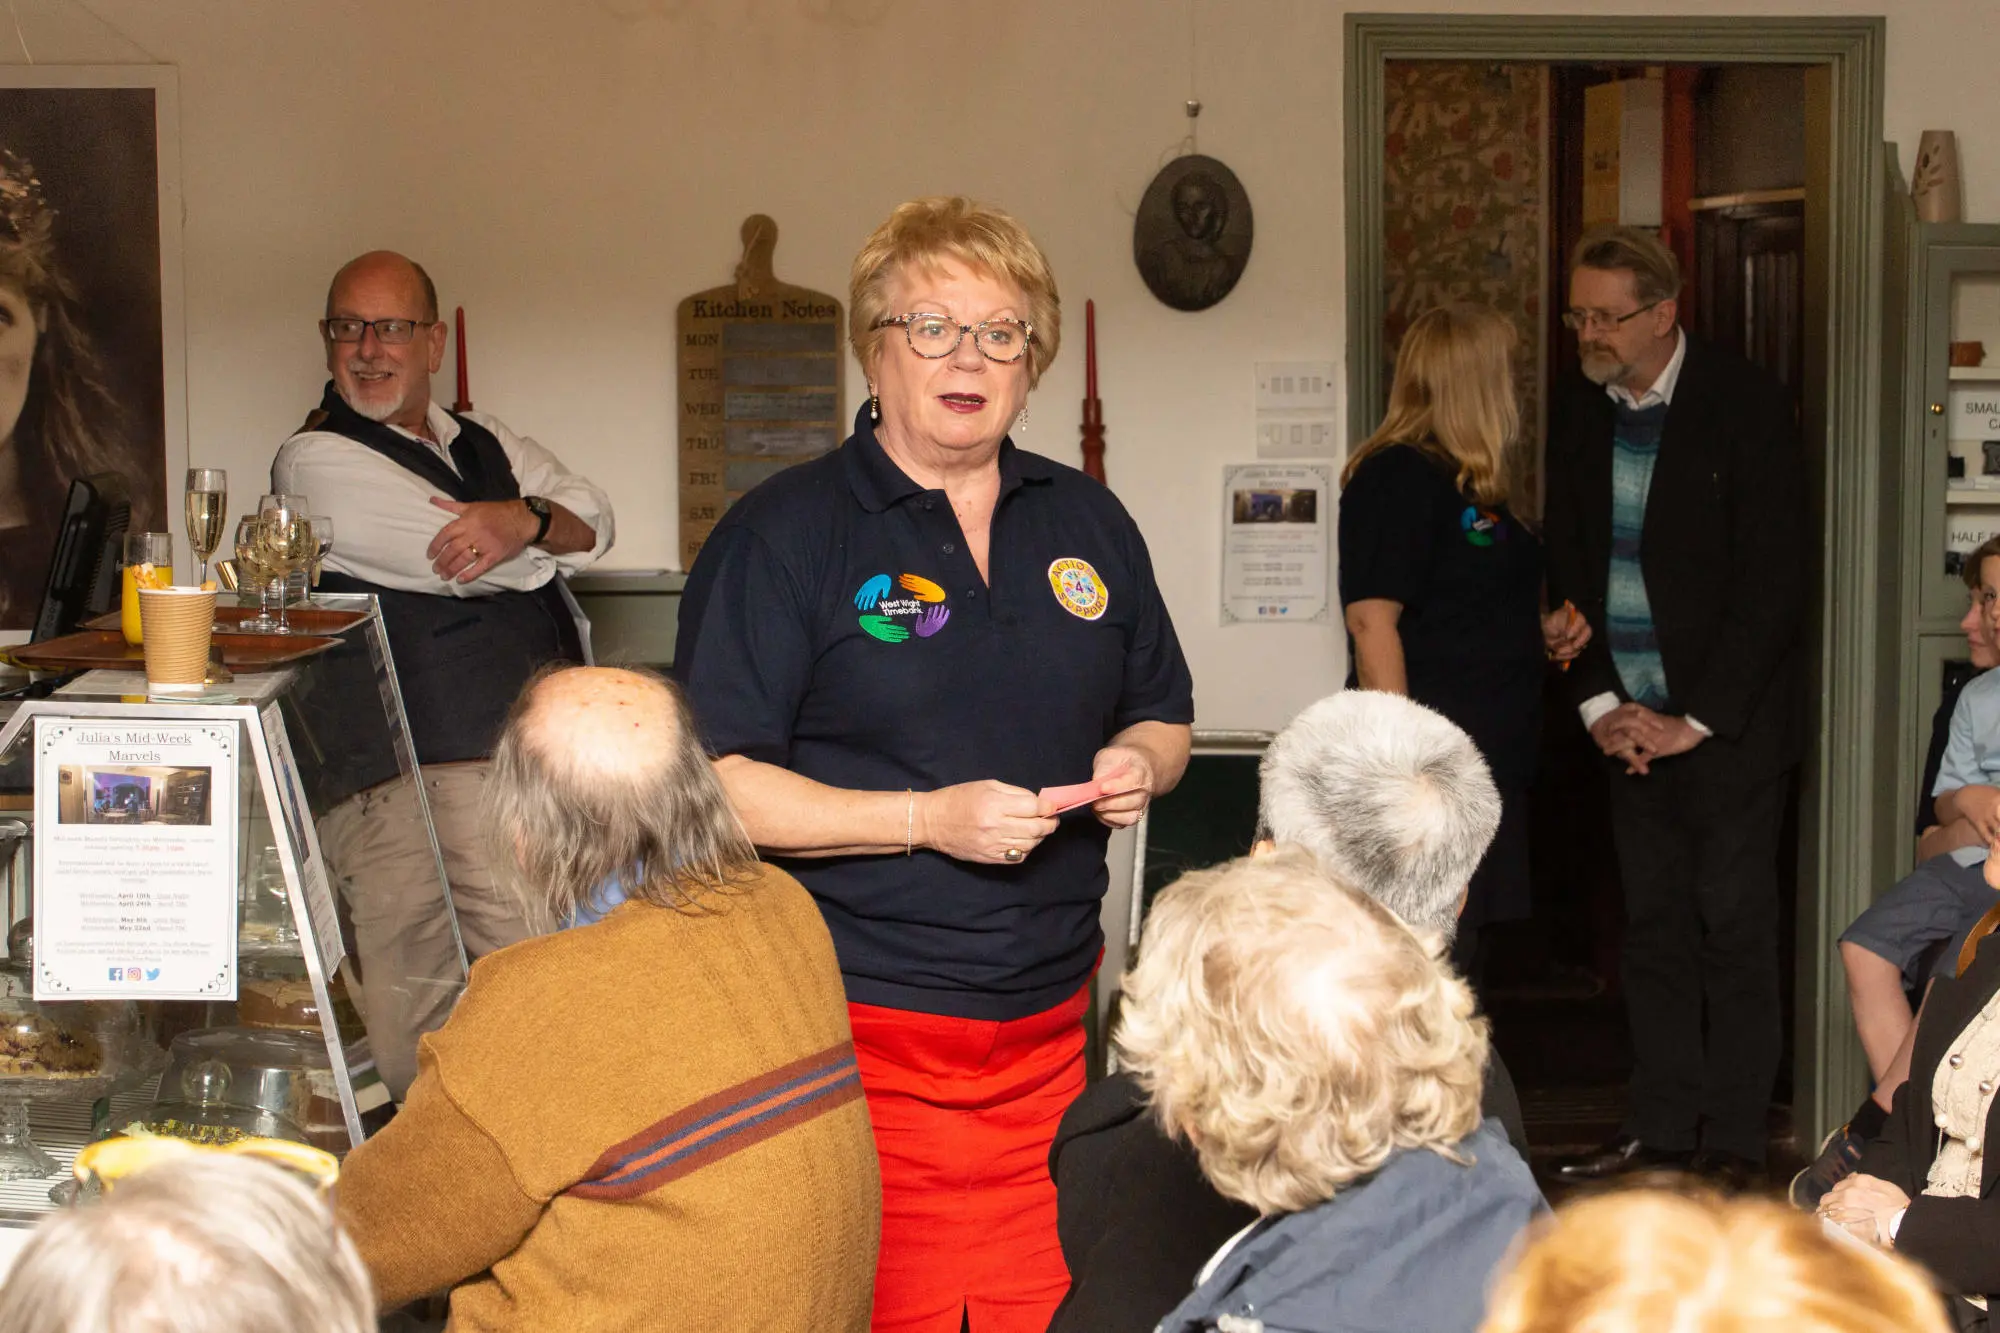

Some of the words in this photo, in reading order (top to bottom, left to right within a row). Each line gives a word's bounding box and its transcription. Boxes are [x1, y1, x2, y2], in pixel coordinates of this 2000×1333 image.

[692, 300, 772, 318] Kitchen
[782, 301, 836, 318] Notes
[685, 333, 719, 346] MON
[688, 368, 719, 380] TUE
[685, 403, 721, 415] WED
[686, 438, 720, 449] THU
[688, 472, 717, 485] FRI
[690, 507, 716, 519] SAT
[1951, 531, 1985, 544] HALF
[1052, 560, 1095, 579] ACTION
[1075, 581, 1084, 593] 4
[879, 600, 900, 609] West
[900, 599, 920, 609] Wight
[1058, 592, 1106, 617] SUPPORT
[882, 607, 924, 616] Timebank
[76, 731, 121, 743] Julia's
[126, 732, 192, 744] Mid-Week
[109, 750, 161, 761] Marvels
